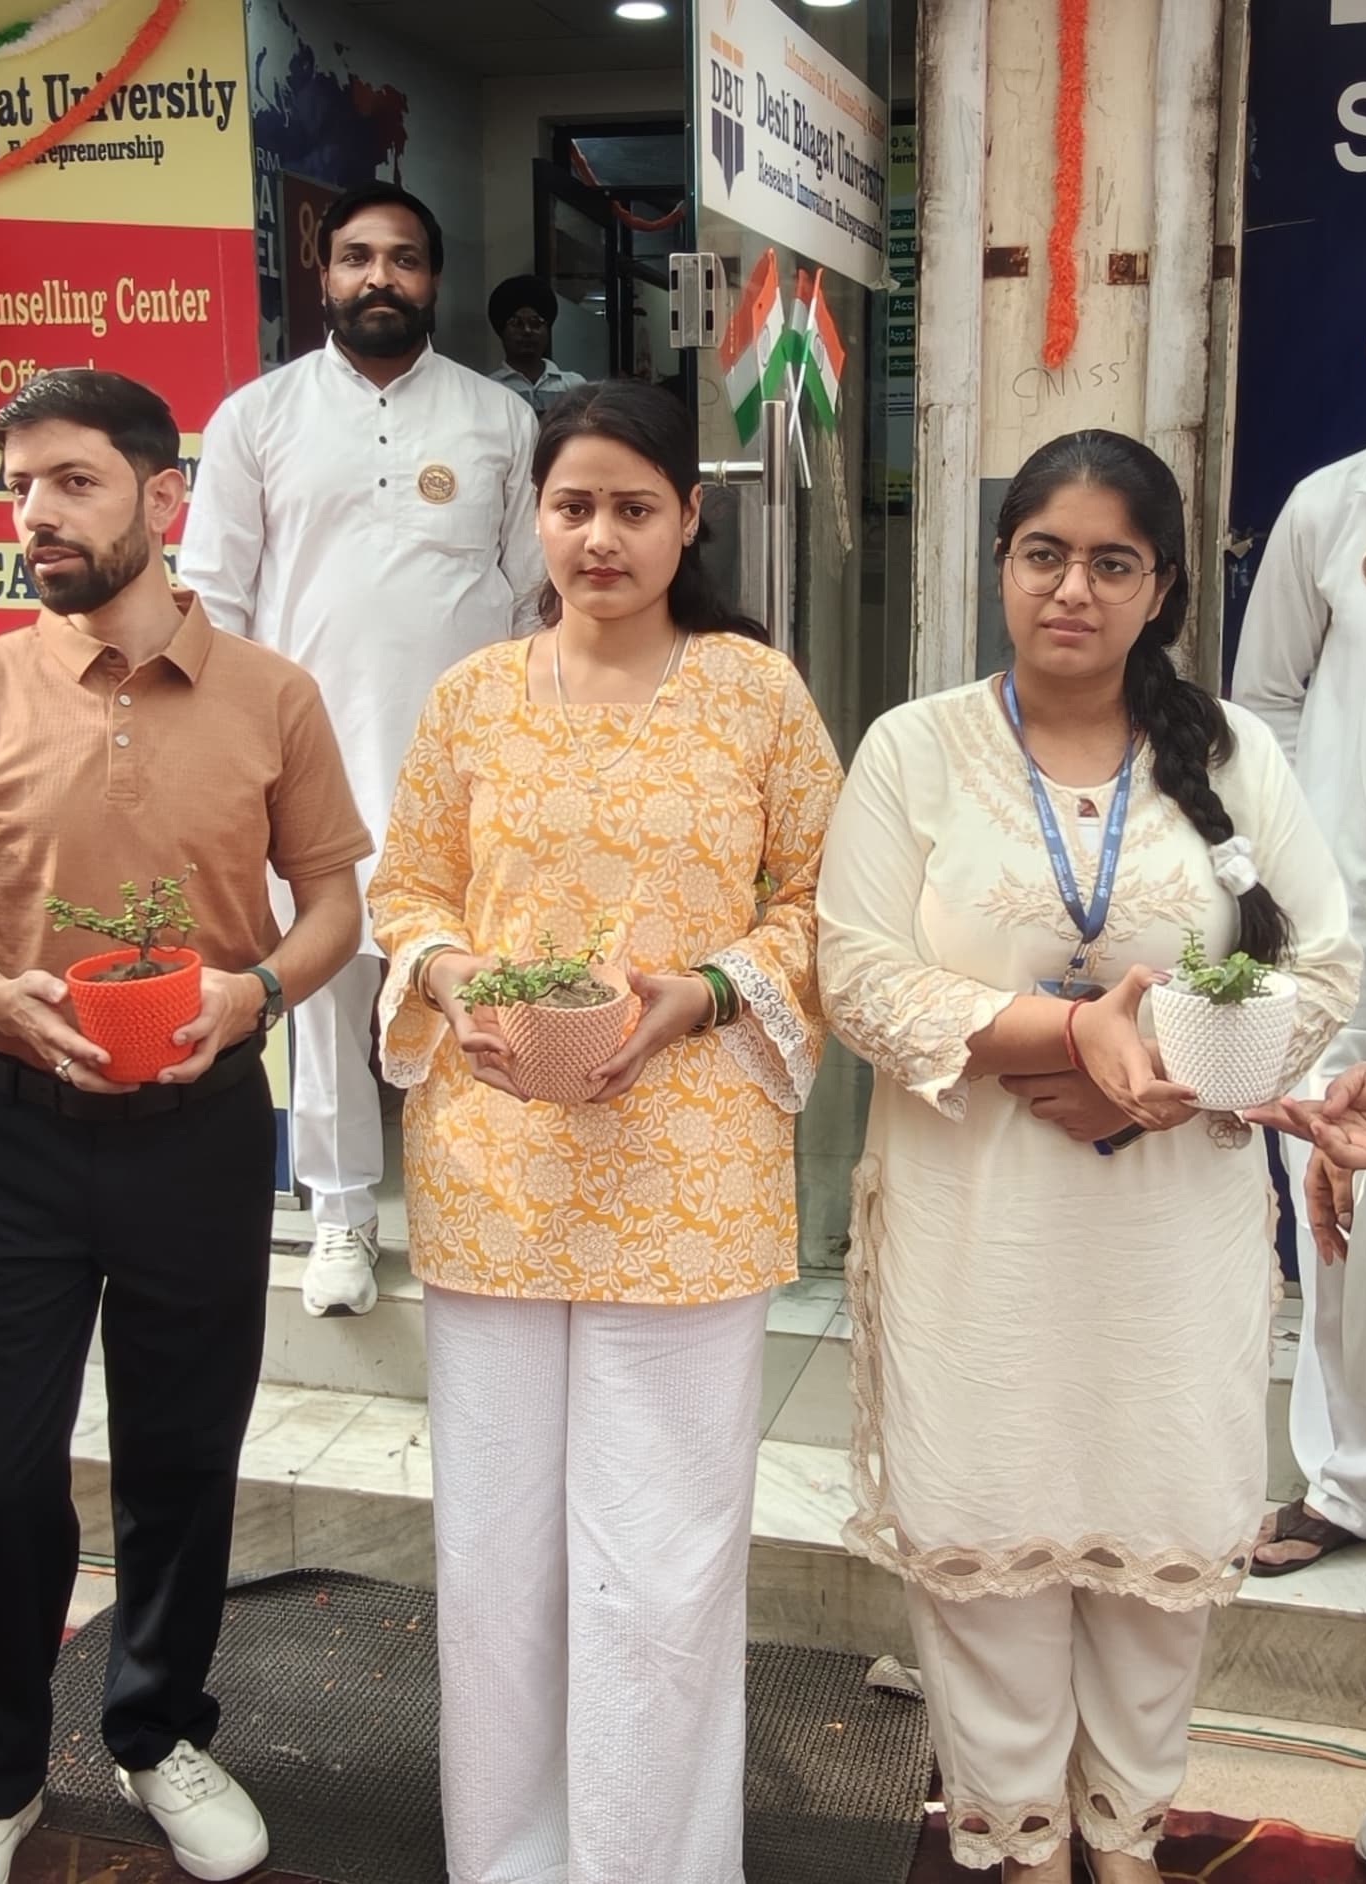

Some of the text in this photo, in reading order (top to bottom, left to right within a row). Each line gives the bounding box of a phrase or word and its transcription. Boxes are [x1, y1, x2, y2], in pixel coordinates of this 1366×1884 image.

[711, 59, 744, 118] DBU
[756, 71, 790, 144] Desh
[793, 98, 834, 181] Bhagat
[115, 277, 211, 323] Center
